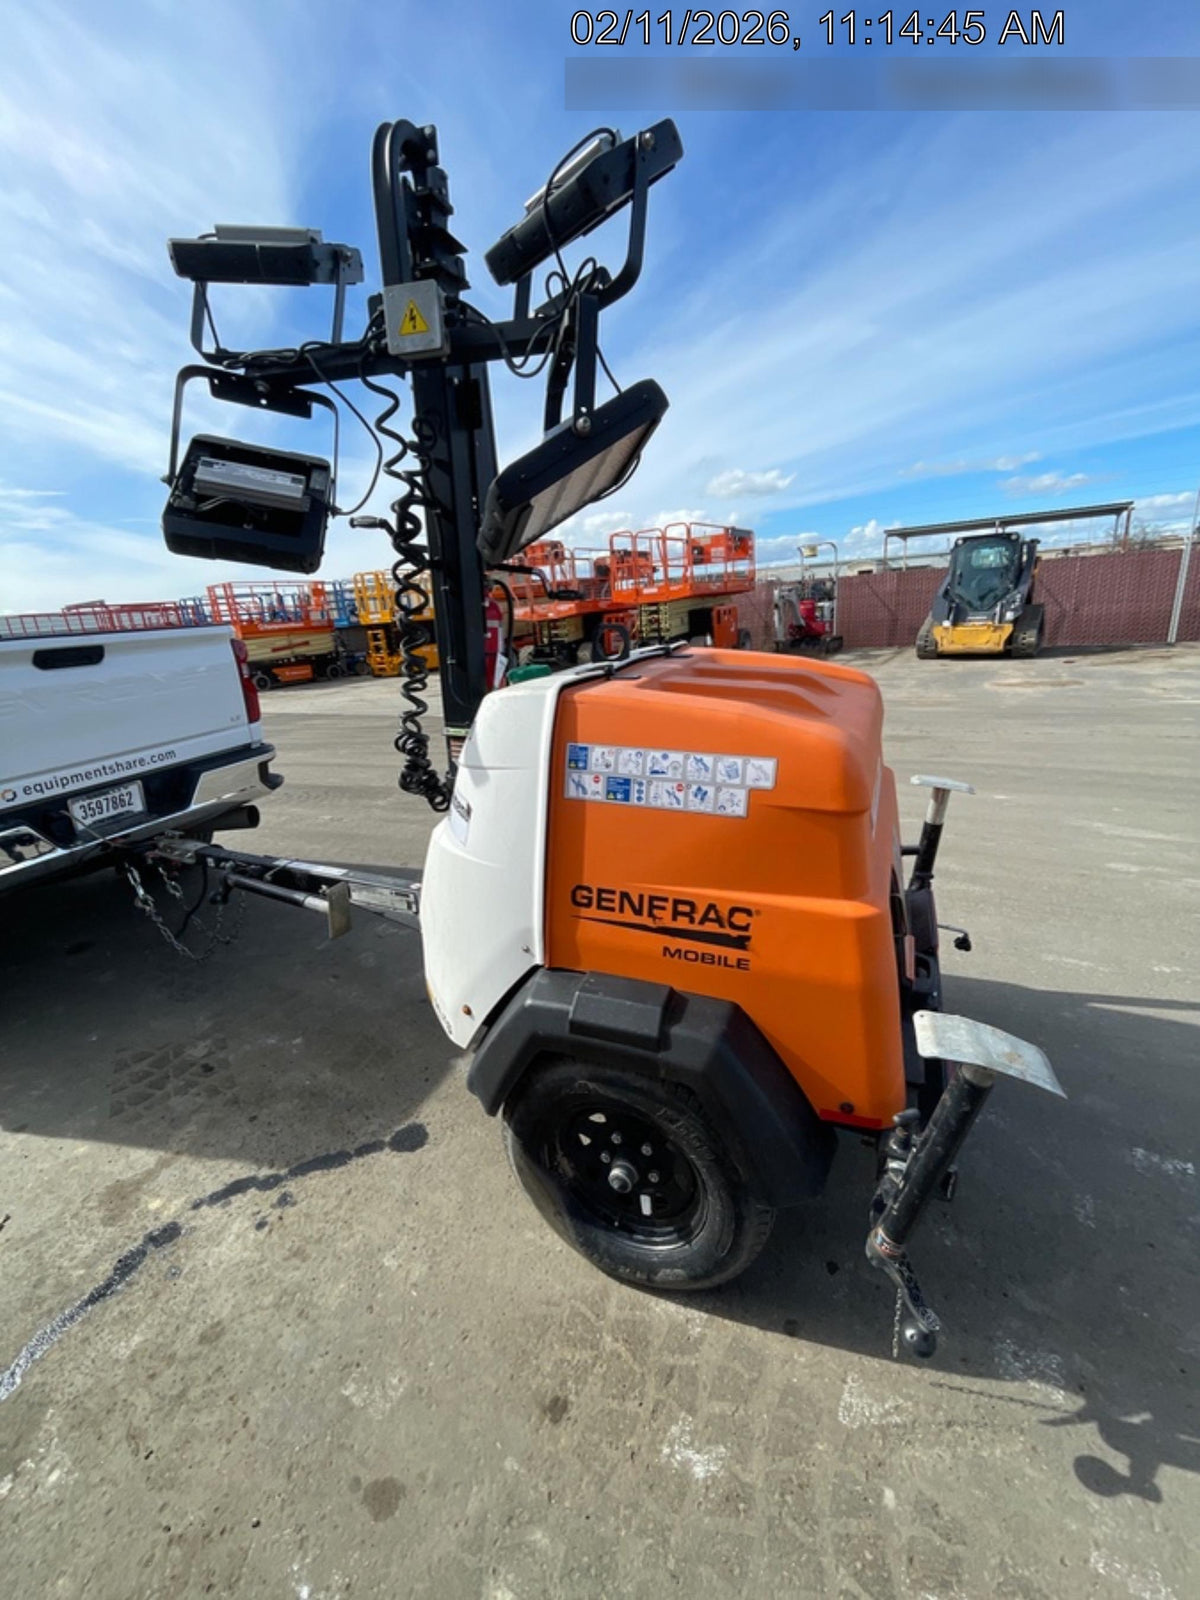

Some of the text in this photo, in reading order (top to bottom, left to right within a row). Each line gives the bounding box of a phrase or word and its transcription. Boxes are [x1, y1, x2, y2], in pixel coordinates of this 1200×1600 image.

[22, 749, 177, 797] equipmentshare.com
[79, 791, 134, 820] 3597862
[570, 884, 753, 932] GENERAC
[662, 946, 751, 971] MOBILE
